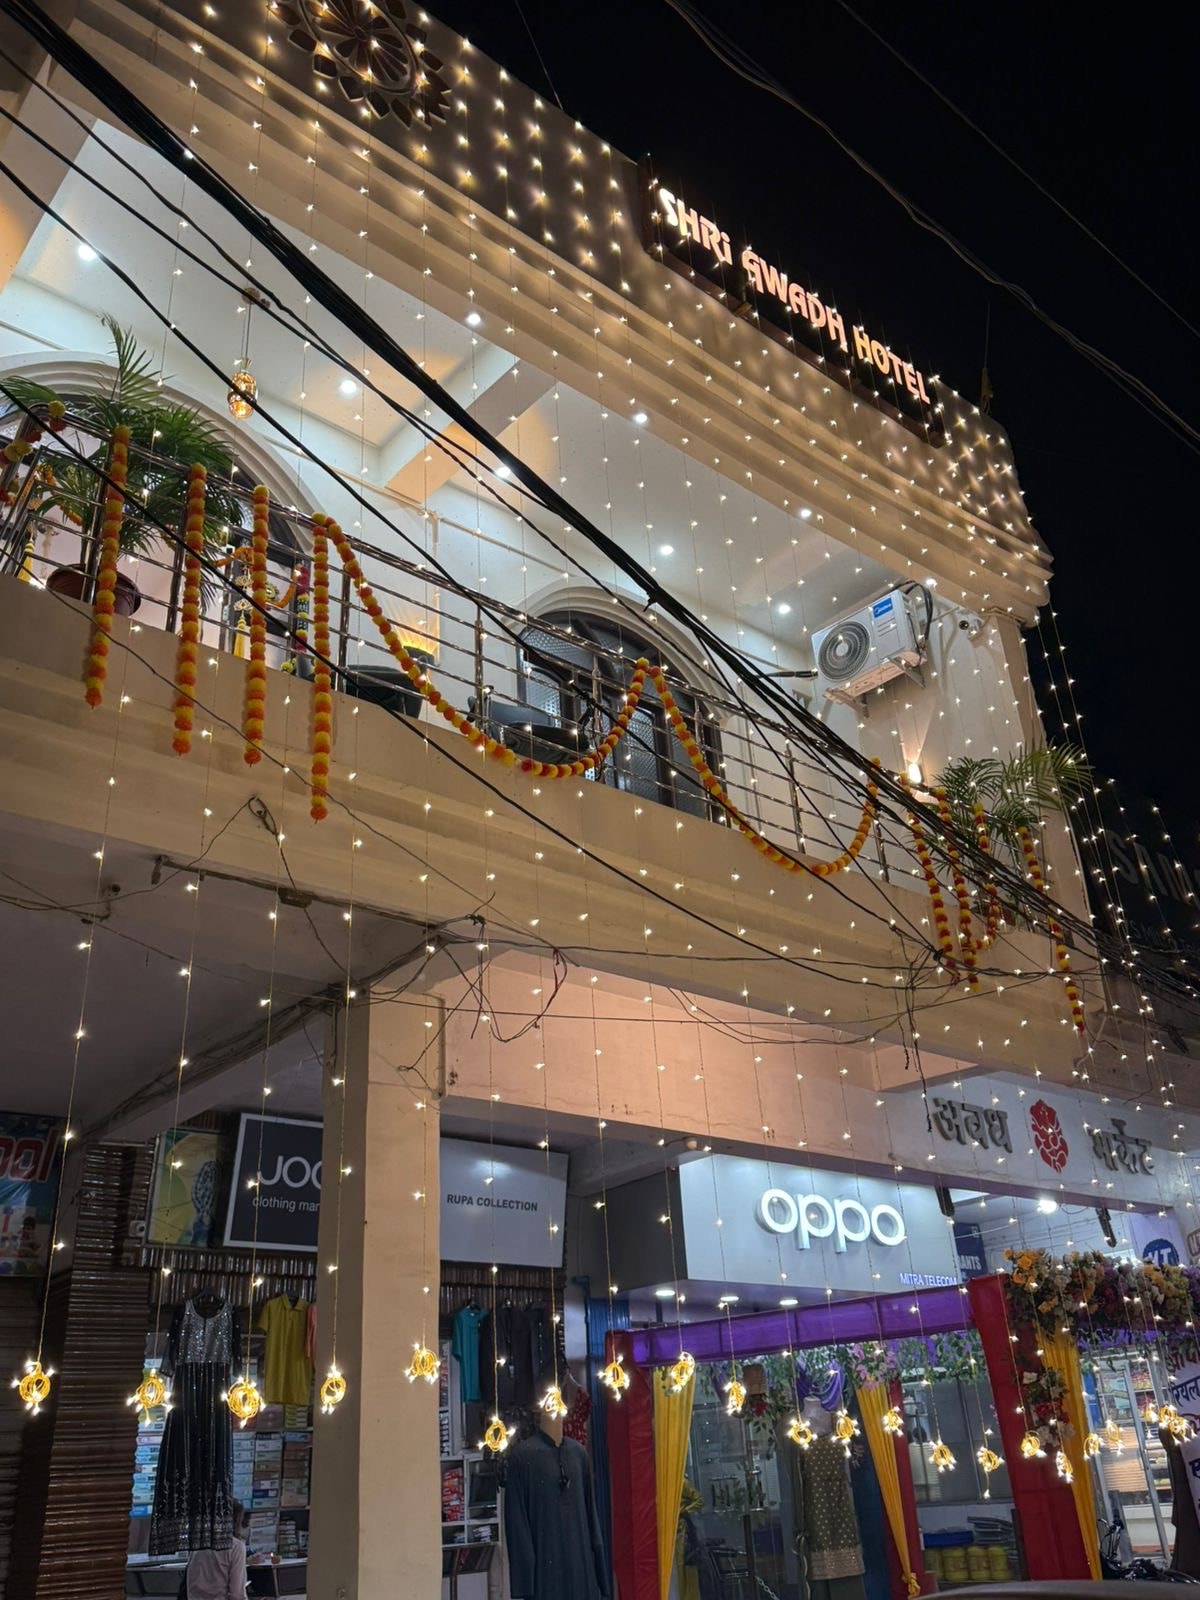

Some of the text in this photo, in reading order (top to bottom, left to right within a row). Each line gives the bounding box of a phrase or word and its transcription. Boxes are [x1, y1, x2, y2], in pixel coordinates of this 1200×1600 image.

[852, 324, 931, 405] HOTEL
[252, 1195, 297, 1214] clothing
[446, 1193, 539, 1212] RUPA COLLECTION
[899, 1272, 958, 1287] MITRA TELECOM
